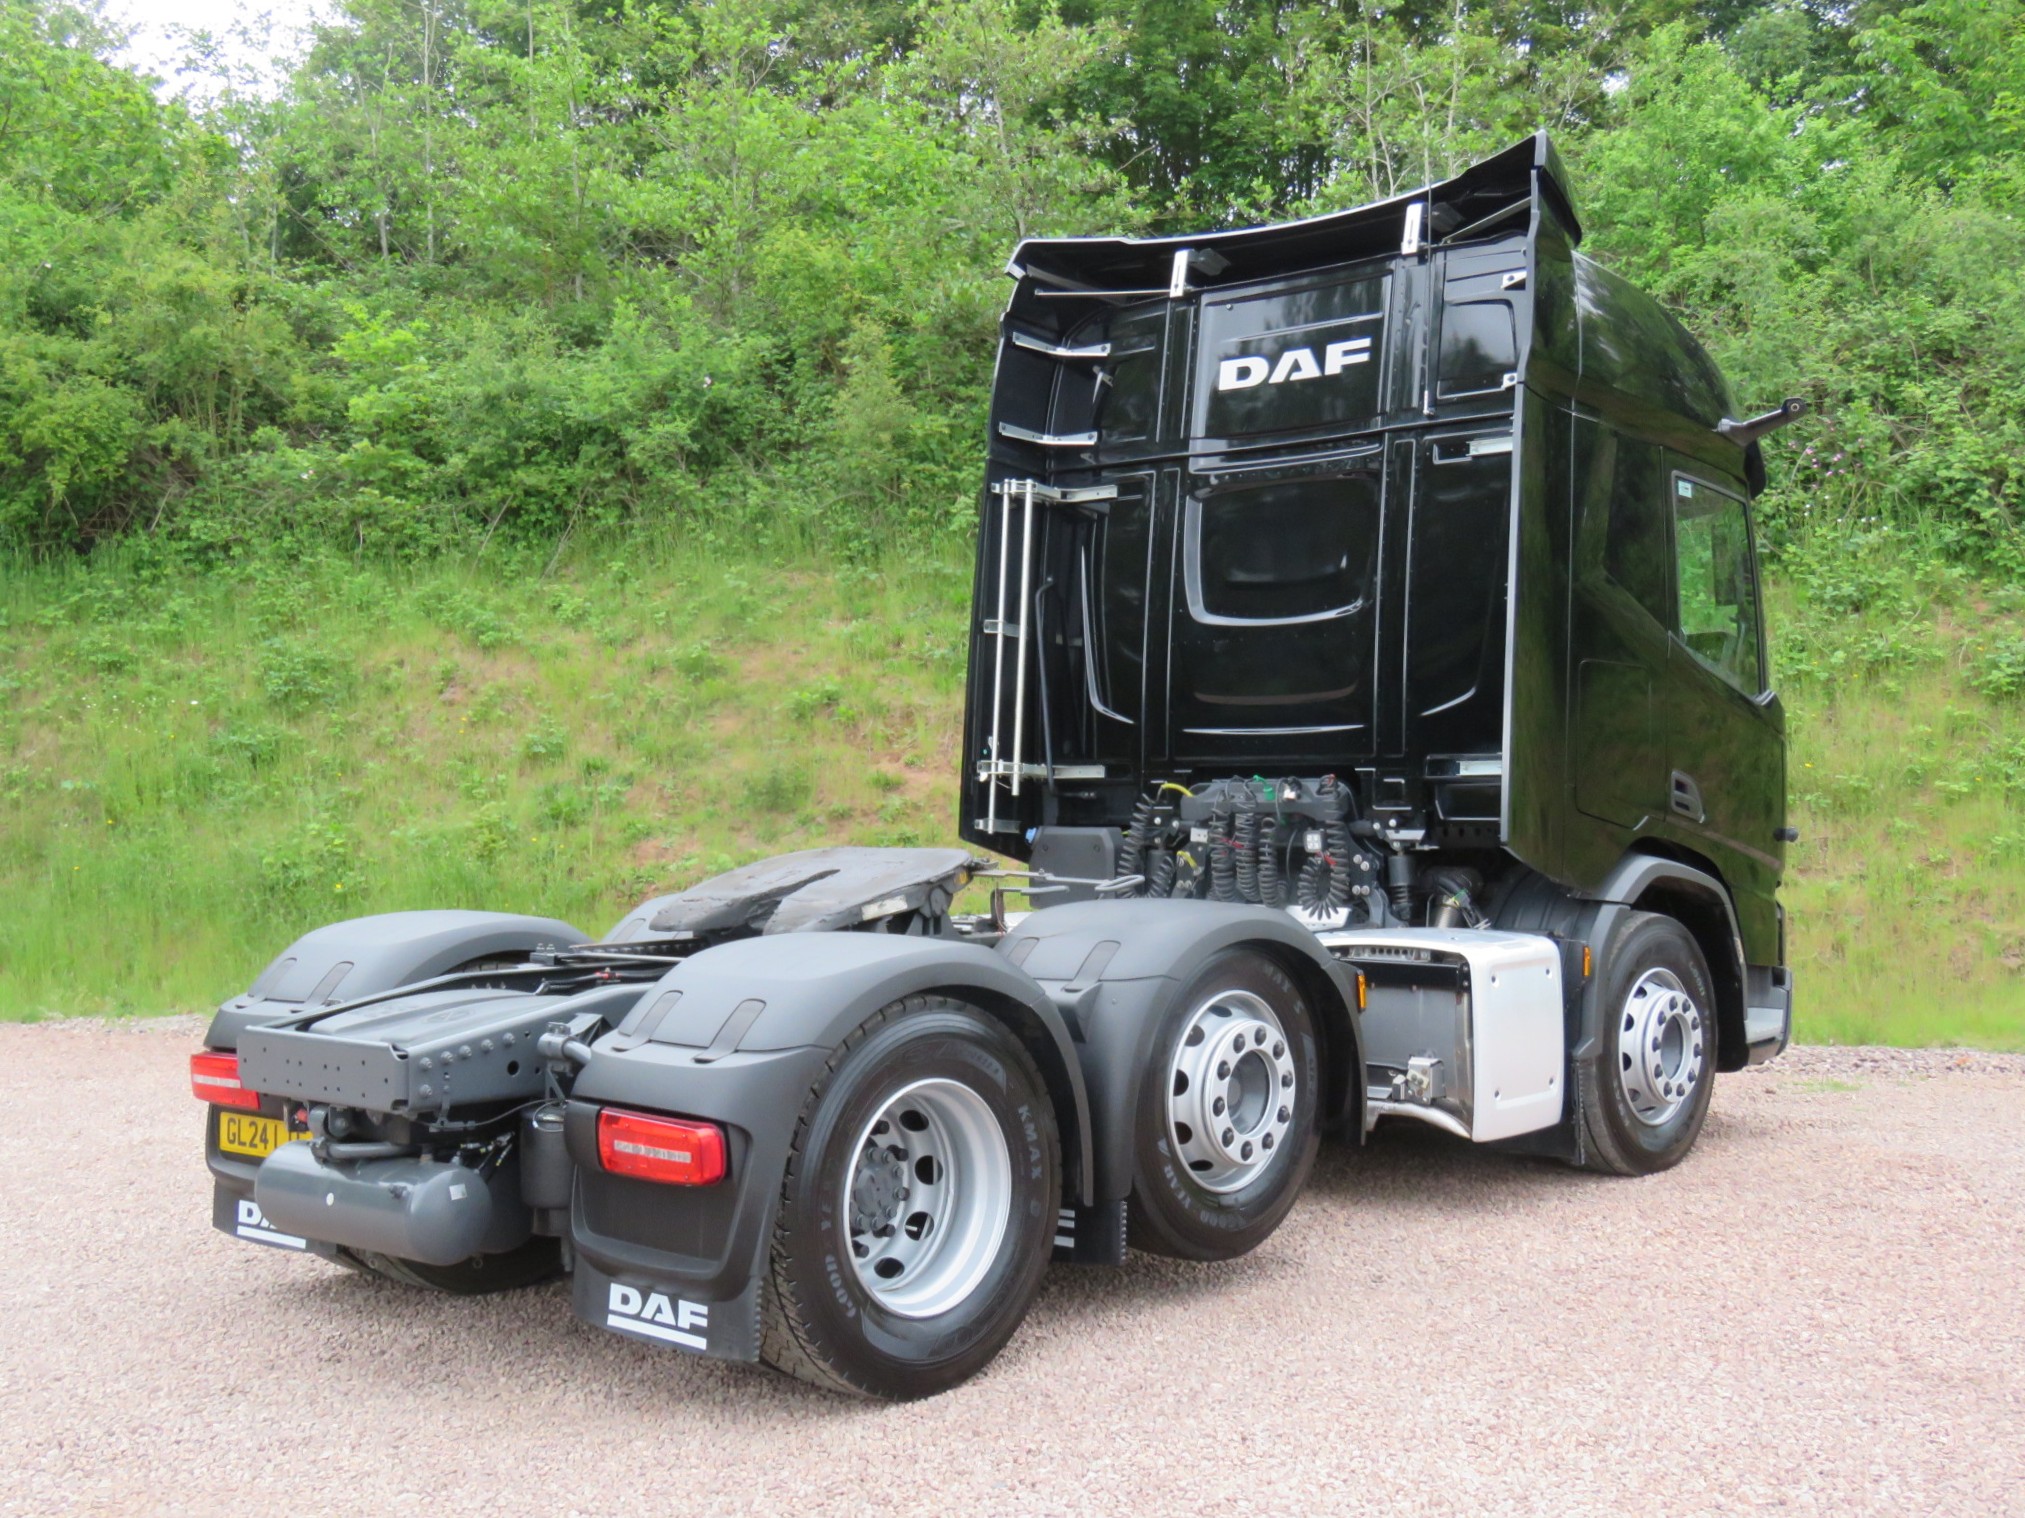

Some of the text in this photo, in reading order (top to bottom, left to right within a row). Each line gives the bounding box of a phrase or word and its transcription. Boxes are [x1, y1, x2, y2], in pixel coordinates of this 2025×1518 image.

[1219, 338, 1372, 391] DAF
[226, 1117, 270, 1151] GL24
[1018, 1104, 1042, 1180] KMAX
[607, 1282, 709, 1331] DAF
